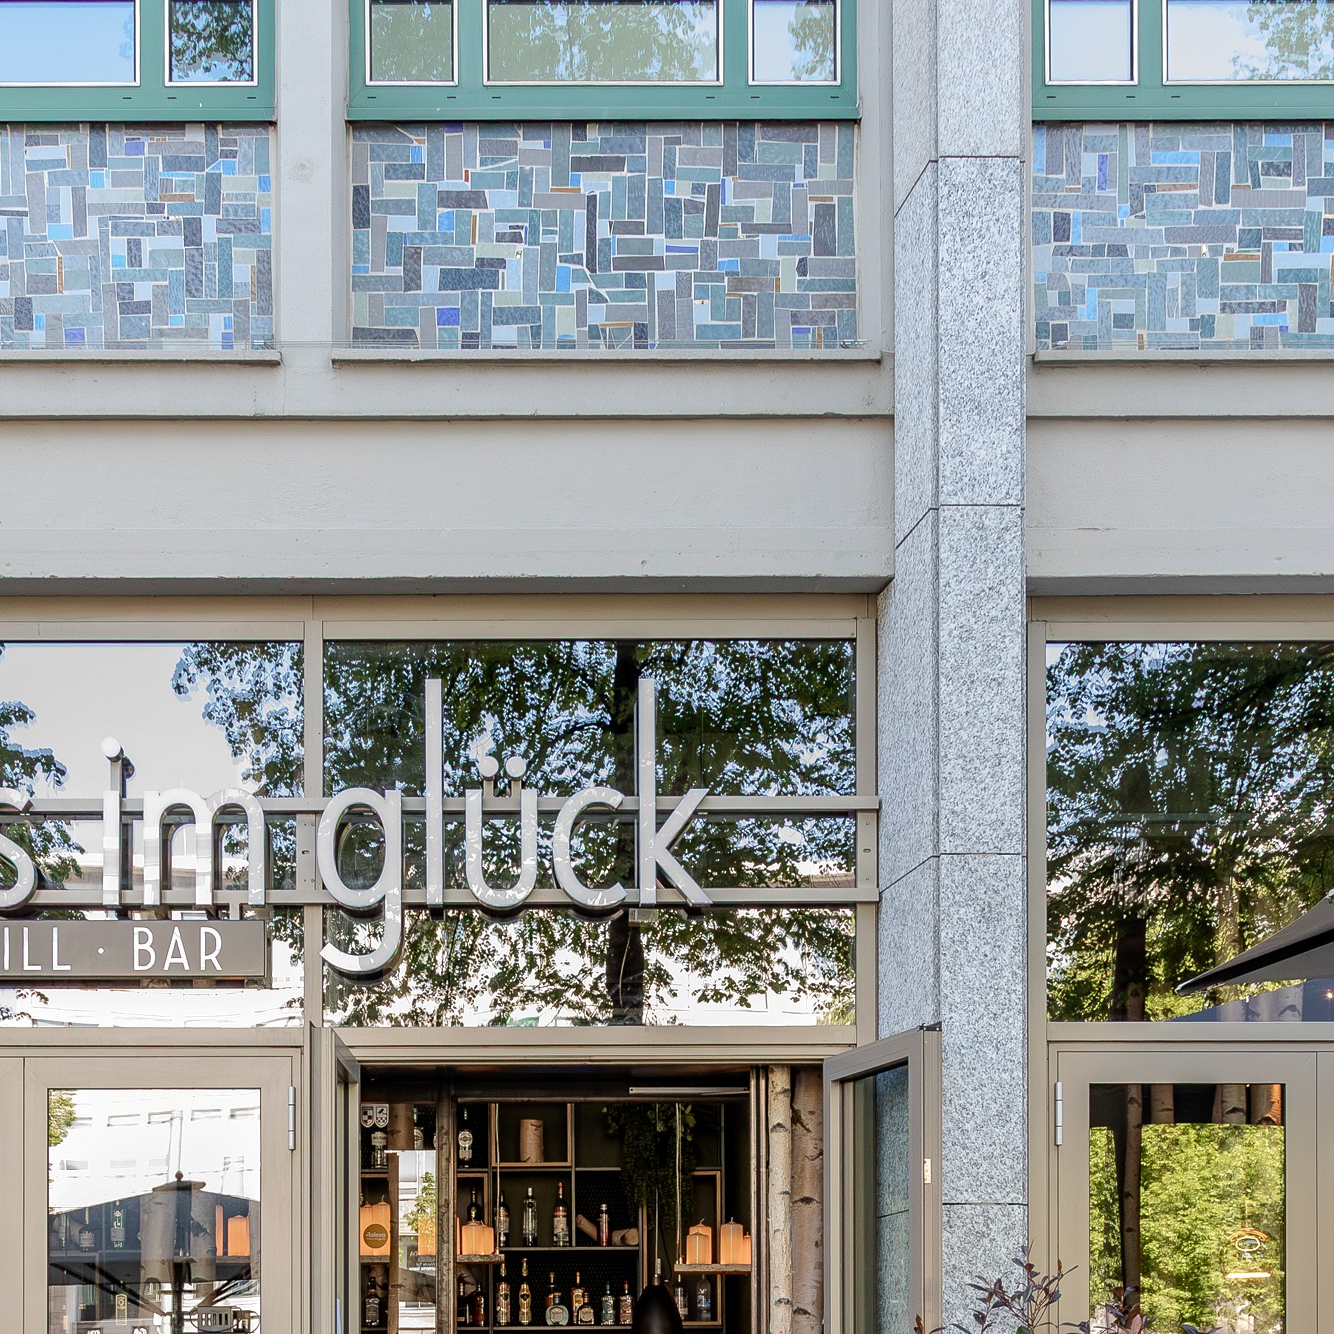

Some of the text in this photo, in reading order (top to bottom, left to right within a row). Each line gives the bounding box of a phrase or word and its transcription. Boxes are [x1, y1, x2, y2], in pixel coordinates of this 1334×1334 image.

[100, 737, 267, 907] im
[317, 677, 713, 973] glück
[133, 925, 223, 972] BAR
